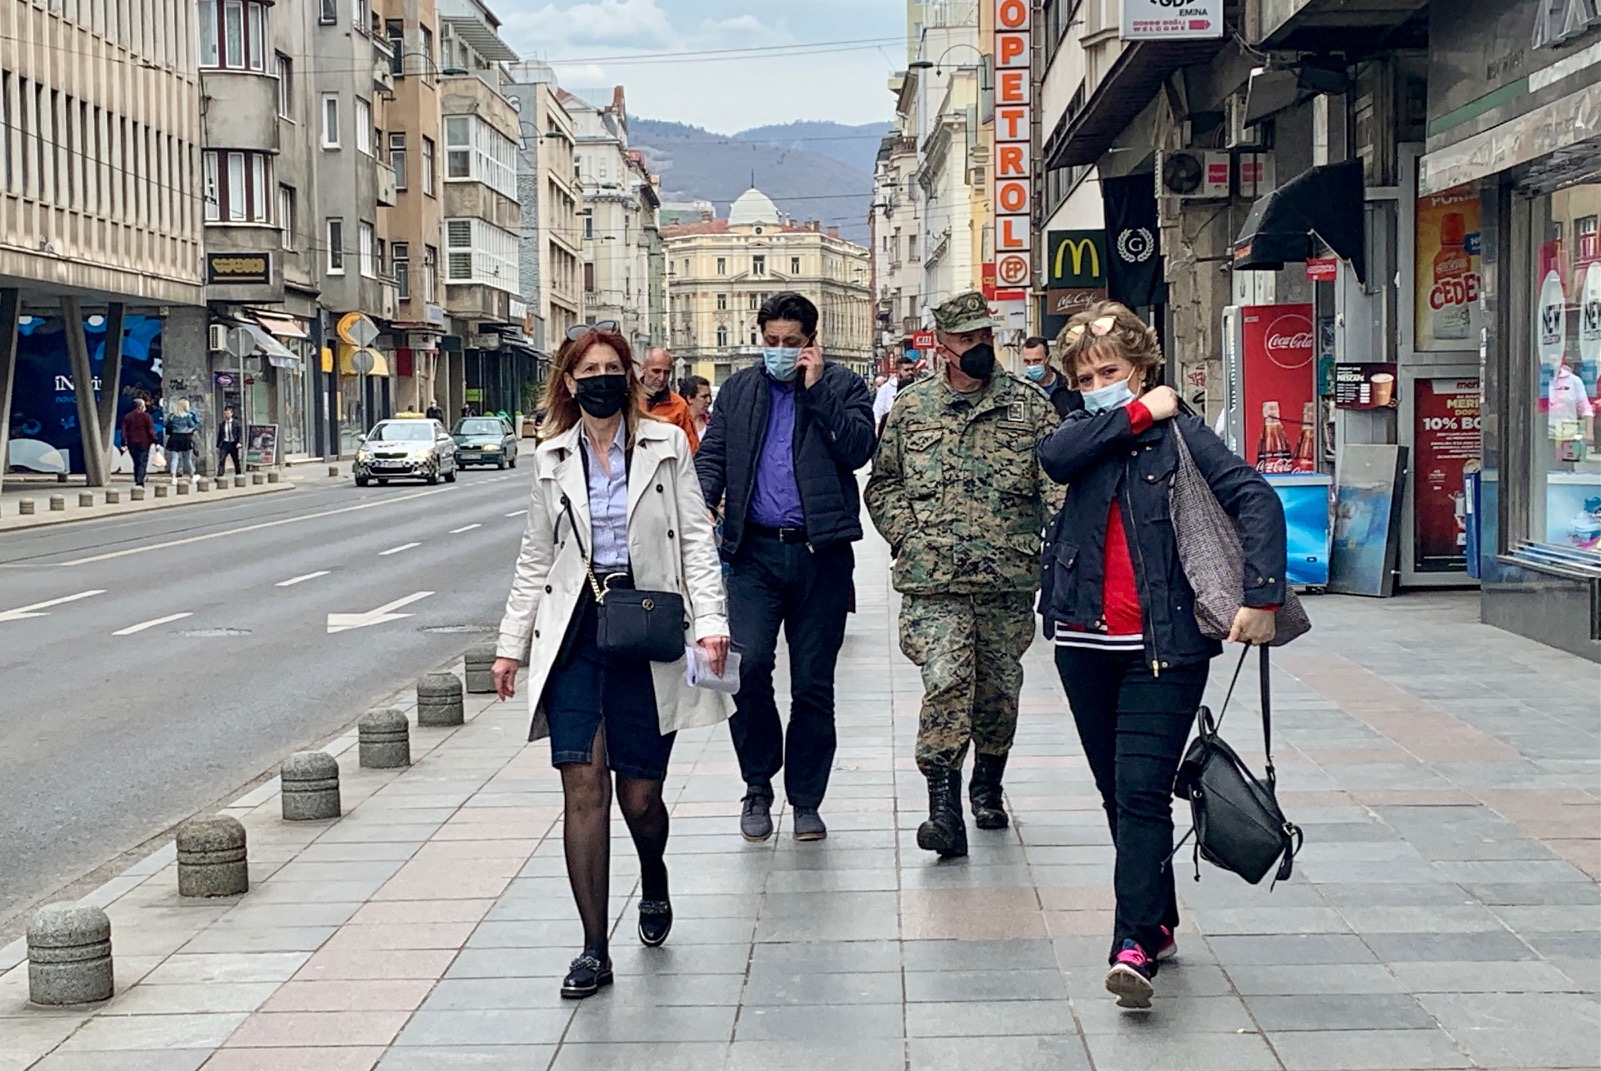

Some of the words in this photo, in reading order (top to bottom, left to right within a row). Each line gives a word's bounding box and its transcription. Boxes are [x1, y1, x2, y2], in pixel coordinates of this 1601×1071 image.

[1163, 18, 1186, 26] DOŠLI
[1000, 0, 1026, 248] OPETROL
[1542, 303, 1562, 334] NEW
[1584, 298, 1601, 330] NE
[1268, 332, 1313, 350] Coca-Cola
[1423, 417, 1458, 430] 10%
